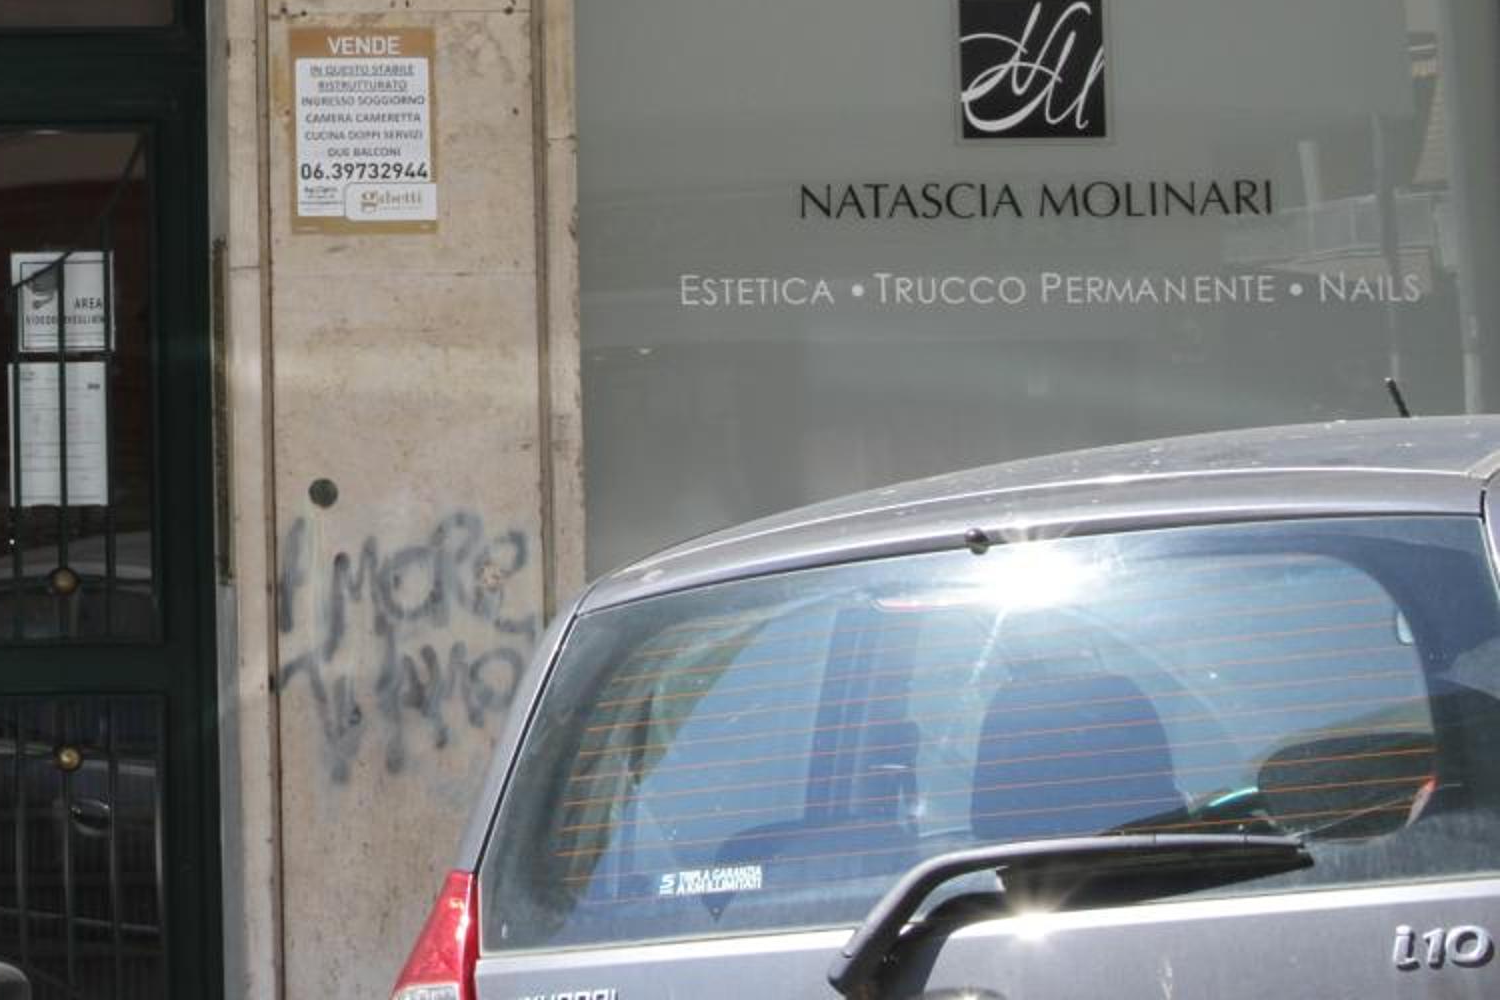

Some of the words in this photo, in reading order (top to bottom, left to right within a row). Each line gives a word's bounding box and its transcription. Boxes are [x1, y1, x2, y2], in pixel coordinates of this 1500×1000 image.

[327, 36, 401, 55] VENDE
[358, 95, 425, 106] SOGGIORNO
[305, 113, 352, 123] CAMERA
[355, 113, 421, 123] CAMERETTA
[304, 130, 345, 141] CUCINA
[347, 130, 380, 140] DOPPI
[383, 129, 423, 140] SERVIZI
[353, 147, 401, 157] BALCONI
[300, 162, 428, 180] 06.39732944
[800, 183, 1023, 219] NATASCIA
[1040, 179, 1272, 217] MOLINARI
[74, 297, 103, 310] AREA
[1392, 924, 1495, 971] i10
